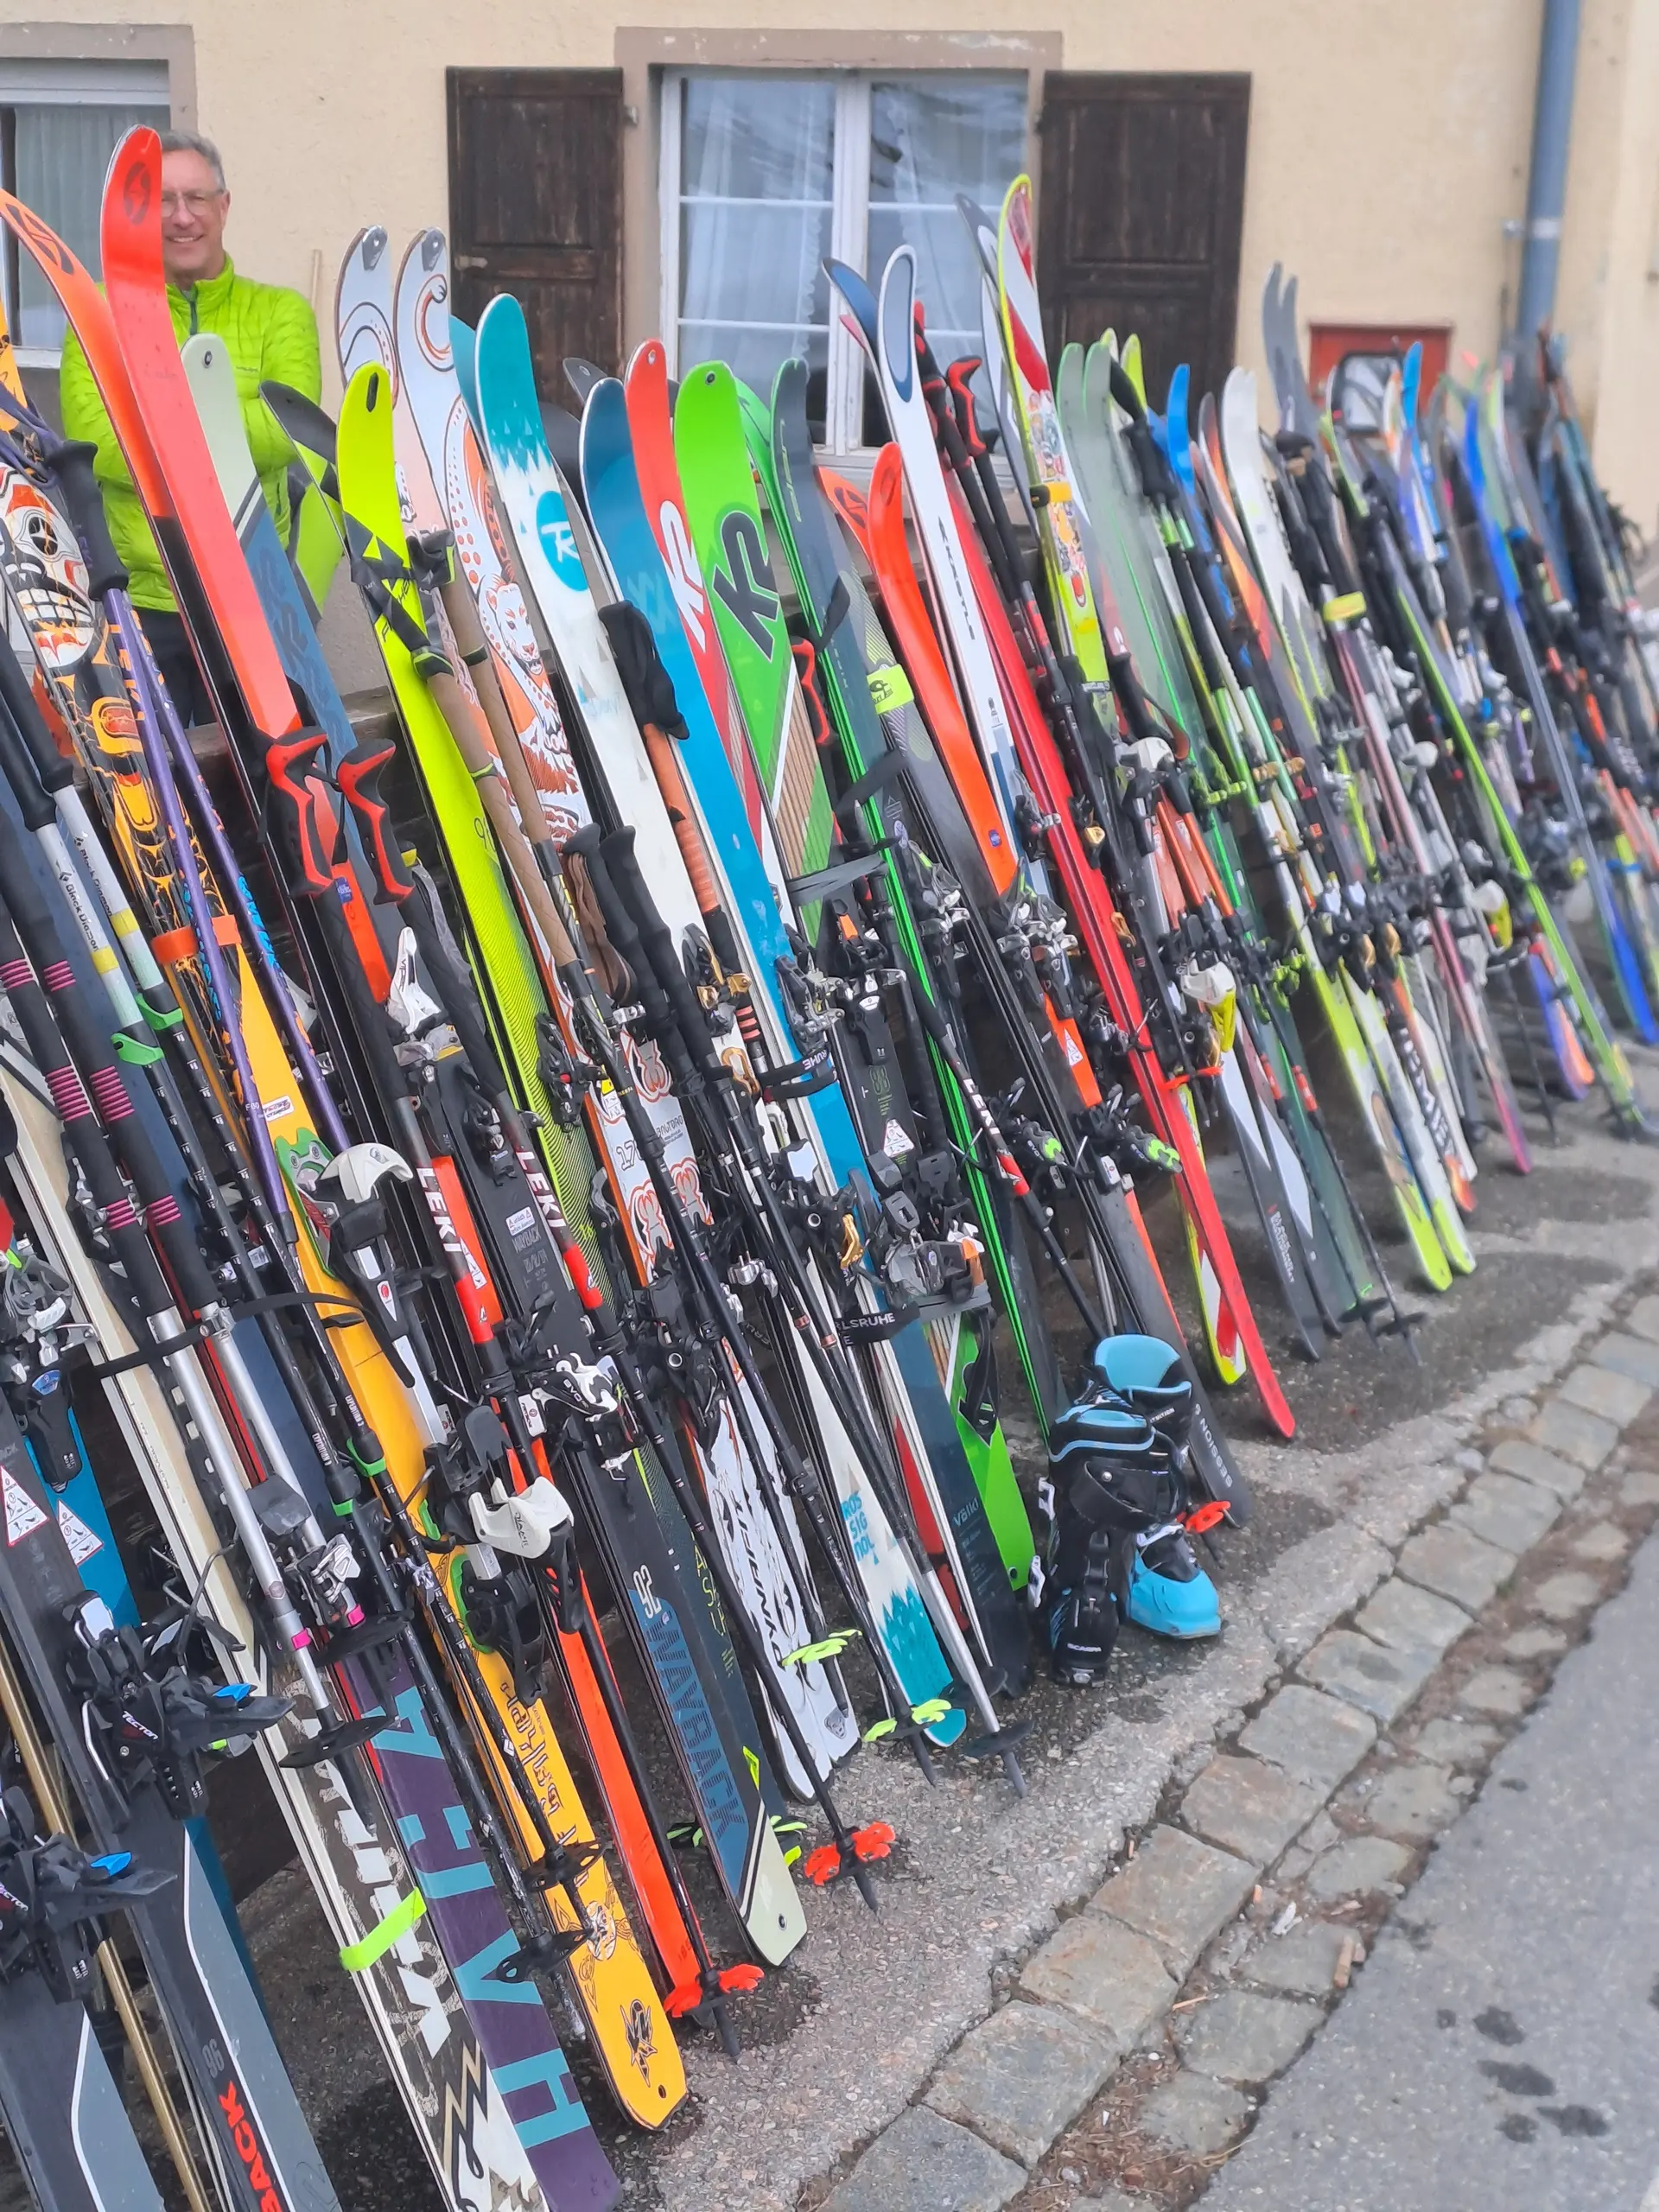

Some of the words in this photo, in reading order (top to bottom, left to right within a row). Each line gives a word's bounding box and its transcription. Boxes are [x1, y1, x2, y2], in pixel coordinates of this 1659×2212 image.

[712, 512, 780, 663] K2
[93, 875, 114, 918] Diamon
[77, 913, 100, 952] Diamon
[964, 1078, 1000, 1135] LEKI
[417, 1168, 462, 1253] LEKI
[517, 1152, 566, 1228] LEKI
[1198, 1418, 1234, 1488] SESSION
[842, 1492, 863, 1522] ROS
[849, 1514, 868, 1541] SIG
[953, 1498, 980, 1528] Völkl
[632, 1563, 663, 1619] 92
[653, 1612, 748, 1836] WAYBACK
[361, 1685, 592, 2149] HAGA
[201, 2040, 225, 2079] 96
